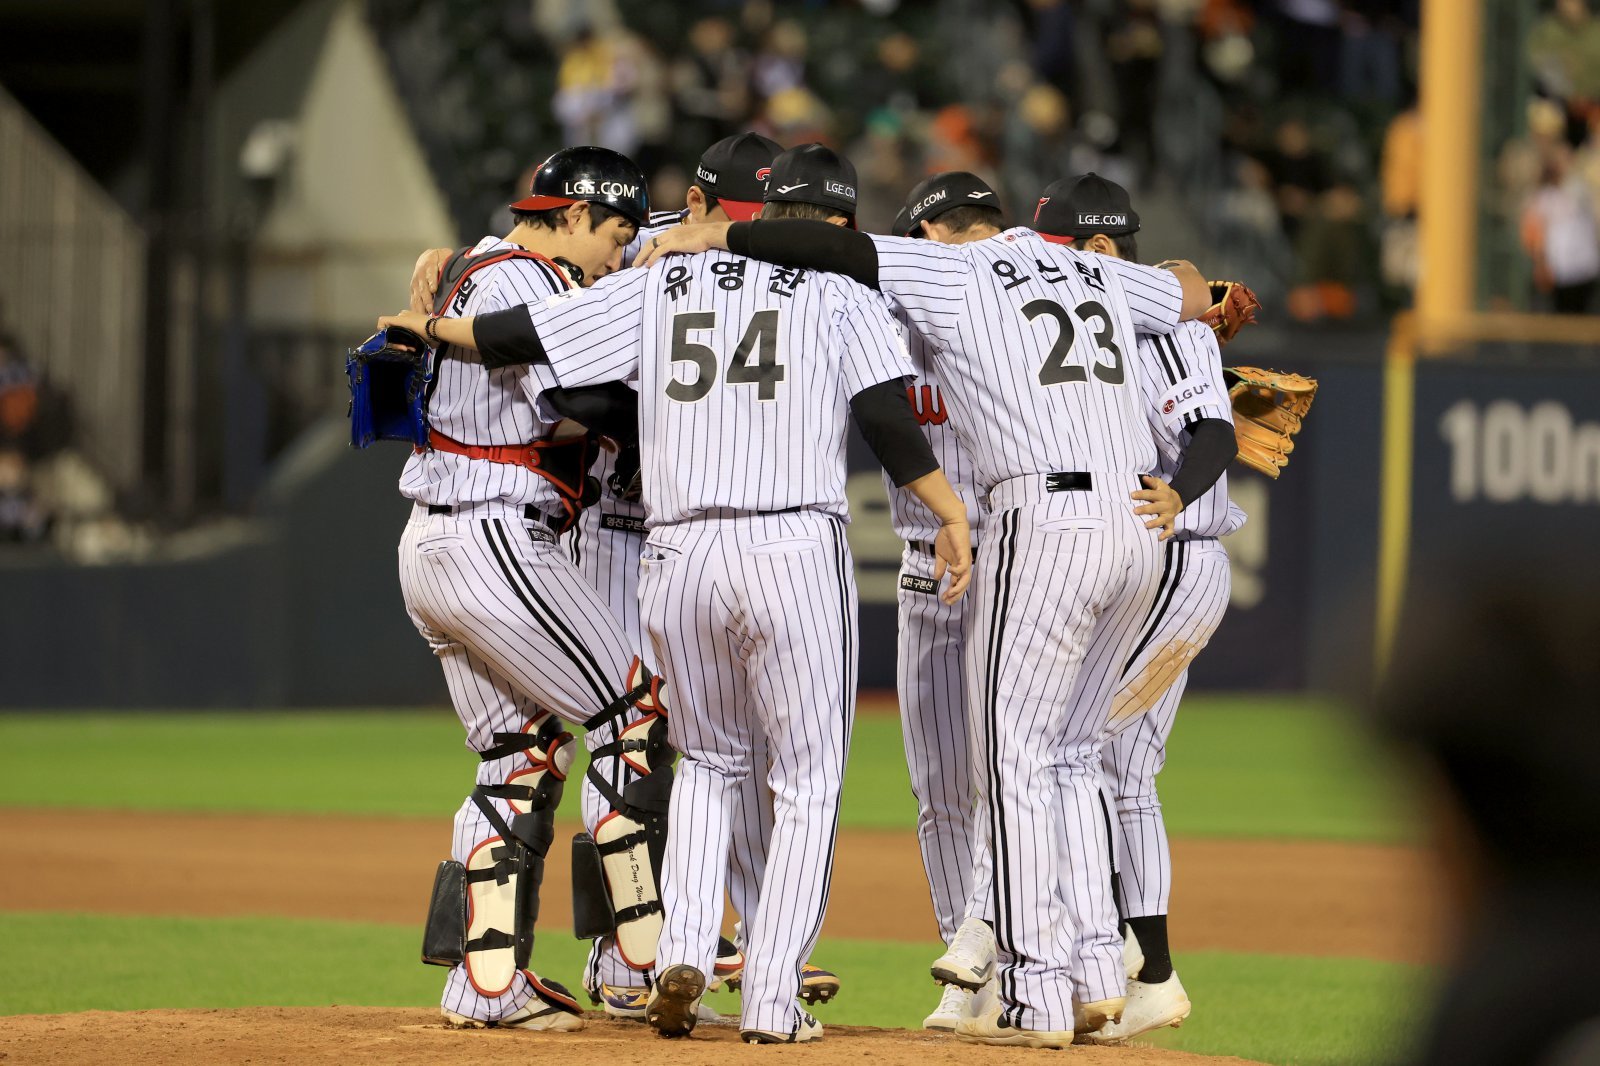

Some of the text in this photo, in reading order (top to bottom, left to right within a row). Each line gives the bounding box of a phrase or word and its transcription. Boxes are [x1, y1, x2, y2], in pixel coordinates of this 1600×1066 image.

[565, 181, 636, 199] LGE.COM
[909, 189, 947, 220] LGE.COM
[1078, 214, 1127, 226] LGE.COM
[664, 309, 787, 404] 54
[1020, 298, 1126, 388] 23
